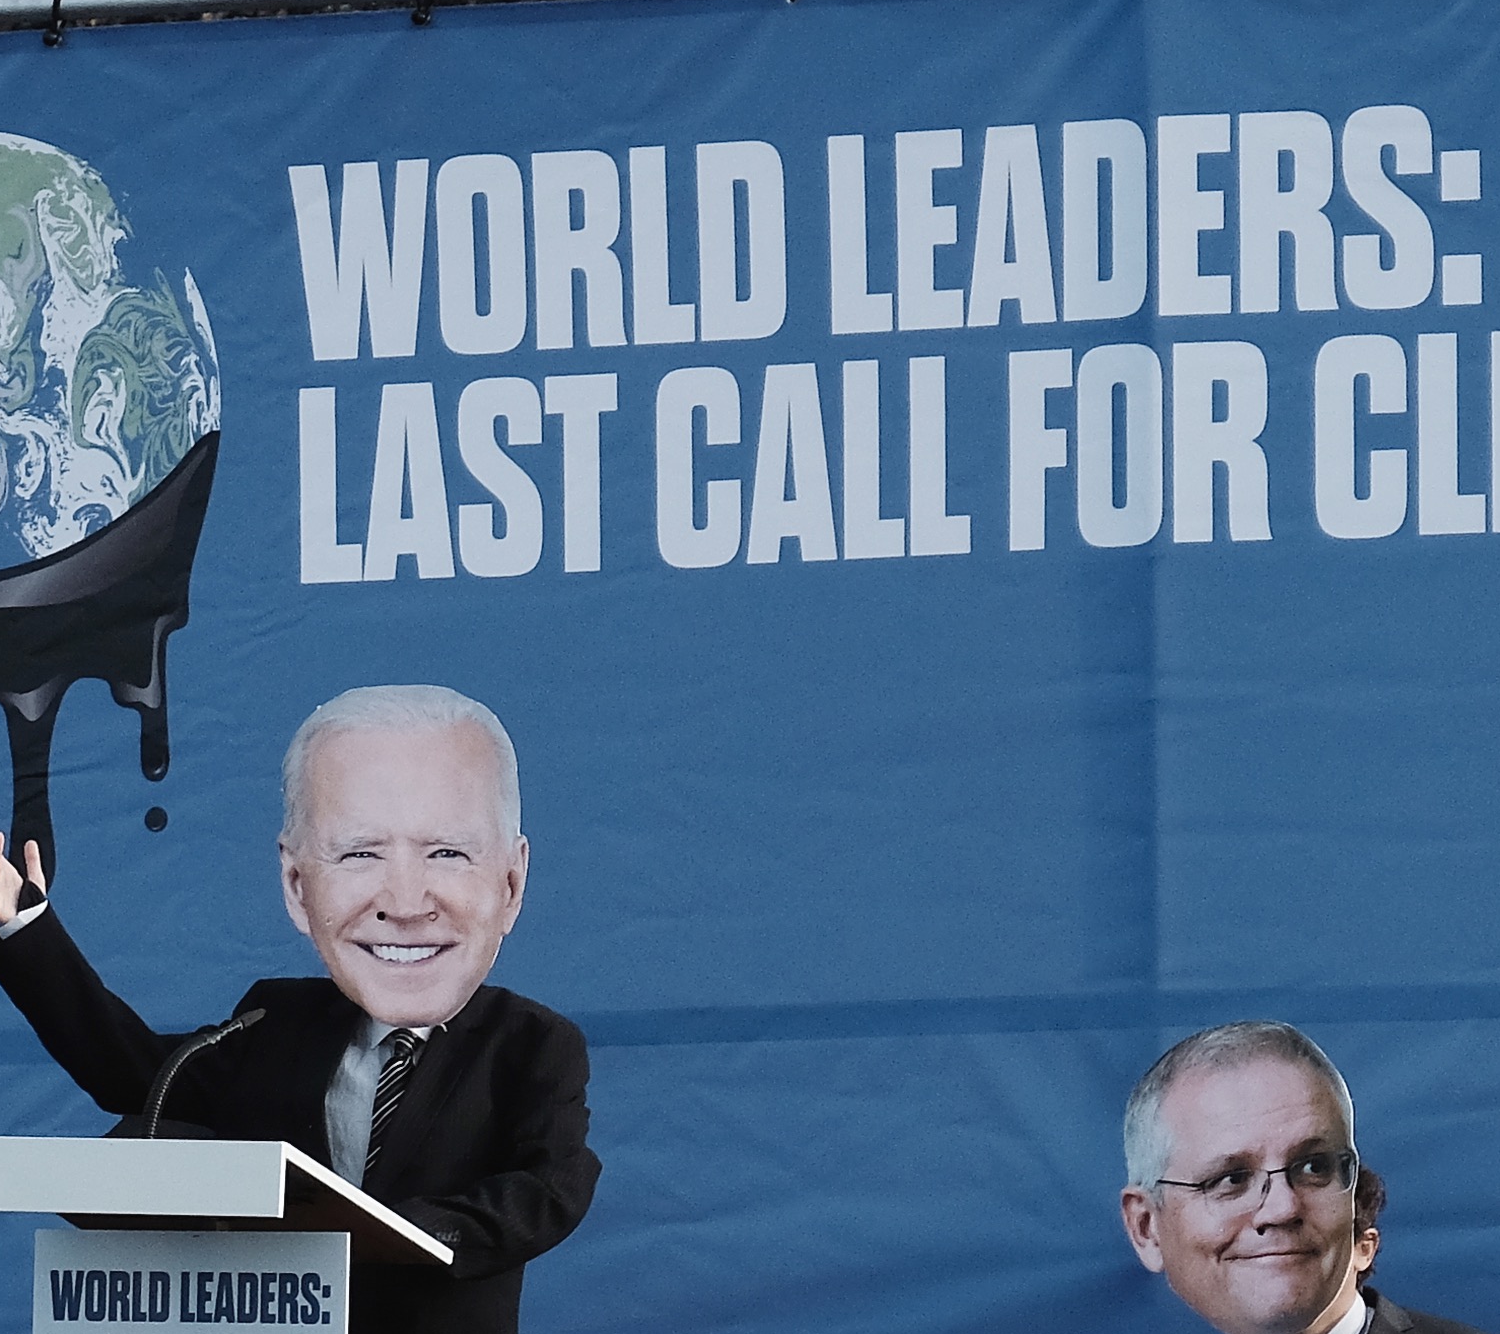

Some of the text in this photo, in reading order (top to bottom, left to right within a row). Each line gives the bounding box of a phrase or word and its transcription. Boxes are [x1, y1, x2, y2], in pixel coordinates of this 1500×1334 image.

[288, 105, 1482, 361] WORLD LEADERS:
[299, 373, 618, 584] LAST
[656, 356, 971, 568] CALL
[1009, 341, 1272, 551] FOR
[50, 1270, 331, 1325] WORLD LEADERS:
